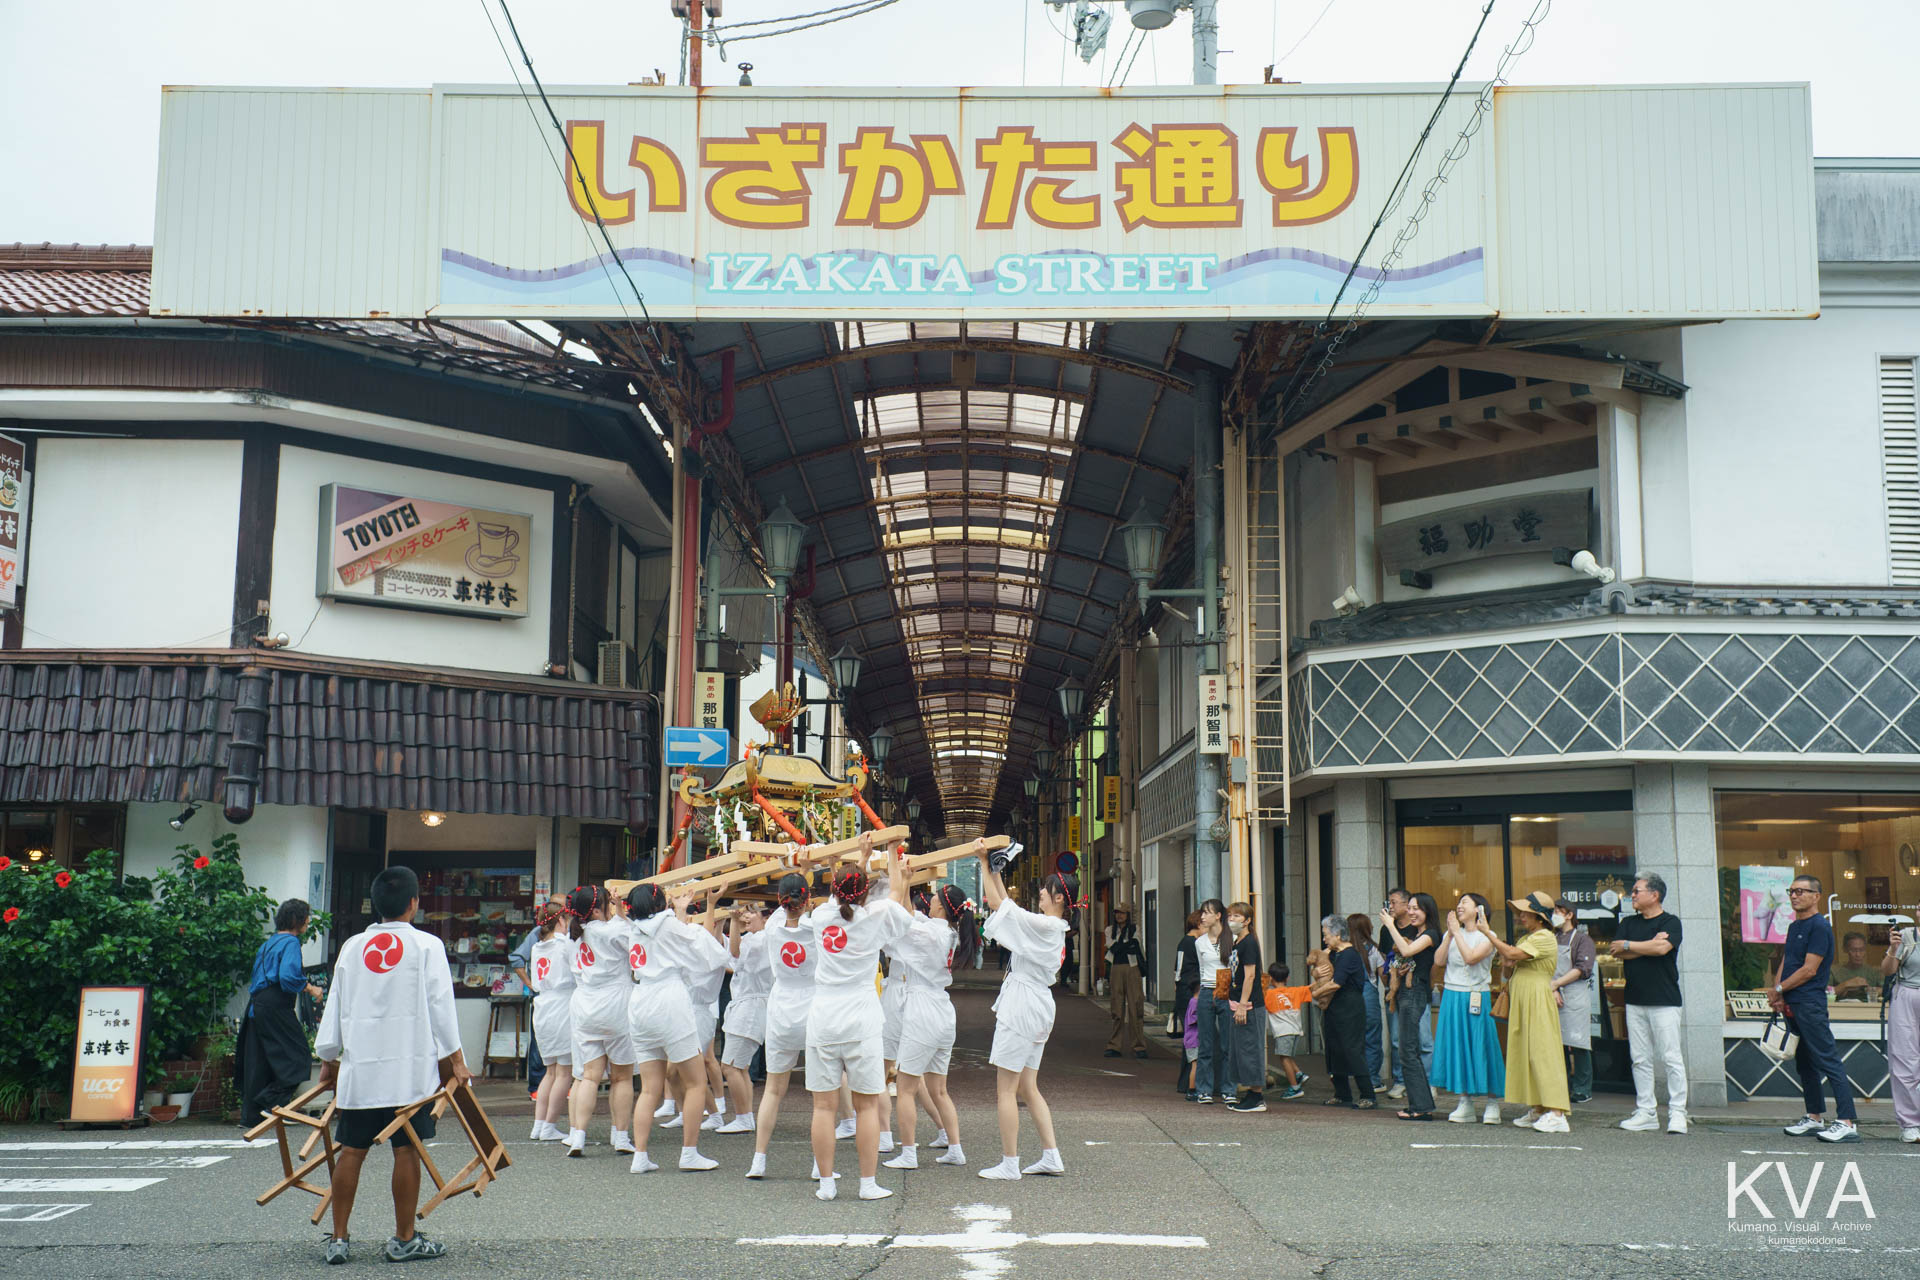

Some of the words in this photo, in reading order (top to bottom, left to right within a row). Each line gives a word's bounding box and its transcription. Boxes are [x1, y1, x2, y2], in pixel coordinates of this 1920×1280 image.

[565, 119, 1360, 233] いざかた通り
[706, 253, 976, 295] IZAKATA
[994, 252, 1217, 296] STREET
[342, 502, 420, 552] TOYOTEI
[1418, 508, 1543, 556] 福助堂
[387, 582, 448, 598] コーヒーハウス
[452, 577, 519, 608] 東洋亭
[1206, 704, 1221, 746] 那智黒
[104, 1018, 130, 1027] お食事
[83, 1039, 130, 1056] 東洋亭
